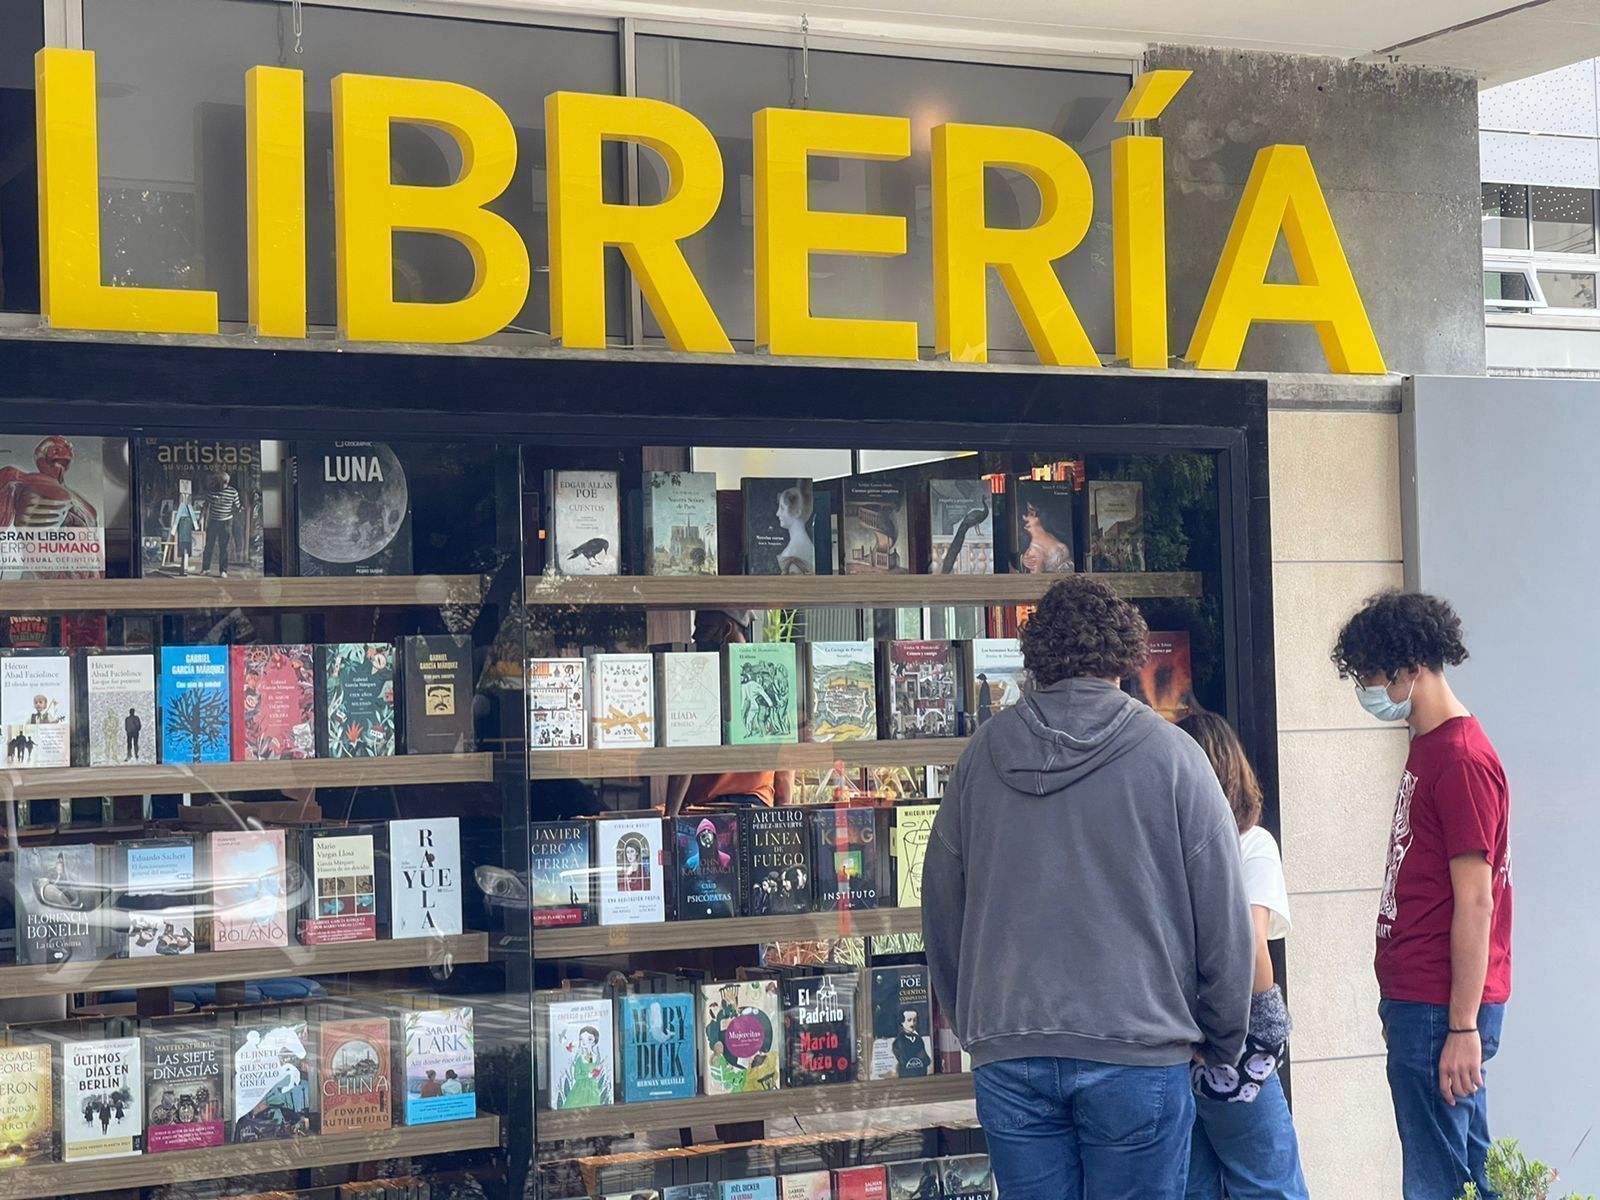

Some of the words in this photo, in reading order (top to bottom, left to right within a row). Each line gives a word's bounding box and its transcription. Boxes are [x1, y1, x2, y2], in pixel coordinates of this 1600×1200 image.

[35, 48, 1387, 375] LIBRERÍA
[157, 440, 252, 463] artistas
[324, 455, 384, 482] LUNA
[560, 481, 586, 489] EDGAR
[588, 481, 613, 489] ALLAN
[576, 489, 597, 499] POE
[569, 504, 605, 512] CUENTOS
[0, 531, 34, 541] GRAN
[38, 531, 76, 541] LIBRO
[79, 531, 99, 541] DEL
[0, 542, 36, 553] ERPO
[38, 542, 100, 553] HUMANO
[1, 555, 18, 563] UÍA
[4, 662, 28, 670] Héctor
[91, 661, 114, 670] Héctor
[172, 664, 195, 675] GARCÍA
[4, 671, 23, 679] Abad
[752, 810, 803, 823] ARTURO
[535, 828, 581, 840] JAVIER
[754, 830, 802, 846] LÍNEA
[316, 842, 336, 850] Mario
[531, 843, 584, 855] CERCAS
[131, 853, 160, 862] Eduardo
[753, 853, 804, 867] FUEGO
[535, 858, 580, 870] TERRA
[687, 892, 732, 903] PSICÓPATAS
[823, 889, 876, 900] INSTITUTO
[27, 911, 89, 925] FLORENCIA
[27, 922, 89, 939] BONELLI
[900, 978, 921, 988] POE
[798, 989, 810, 1006] El
[899, 988, 927, 996] CUENTOS
[799, 1006, 844, 1025] Padrino
[425, 1024, 458, 1036] SARAH
[728, 1031, 761, 1043] Mujercitas
[799, 1031, 839, 1051] Mario
[416, 1034, 468, 1055] LARK
[73, 1052, 121, 1066] ÚLTIMOS
[156, 1053, 180, 1066] LAS
[182, 1050, 215, 1063] SIETE
[240, 1051, 251, 1059] EL
[634, 1041, 685, 1079] DICK
[0, 1062, 36, 1074] EORGE
[239, 1062, 278, 1072] SILENCIO
[800, 1053, 833, 1072] Puzo
[85, 1064, 111, 1078] DÍAS
[114, 1064, 129, 1075] EN
[152, 1063, 219, 1080] DINASTÍAS
[239, 1070, 280, 1081] GONZALO
[0, 1079, 39, 1096] ERÓN
[79, 1076, 121, 1091] BERLÍN
[239, 1079, 266, 1088] GINER
[323, 1075, 389, 1097] CHINA
[334, 1106, 379, 1116] EDWARD
[1, 1120, 38, 1131] RROTA
[323, 1114, 389, 1128] RUTHERFURD
